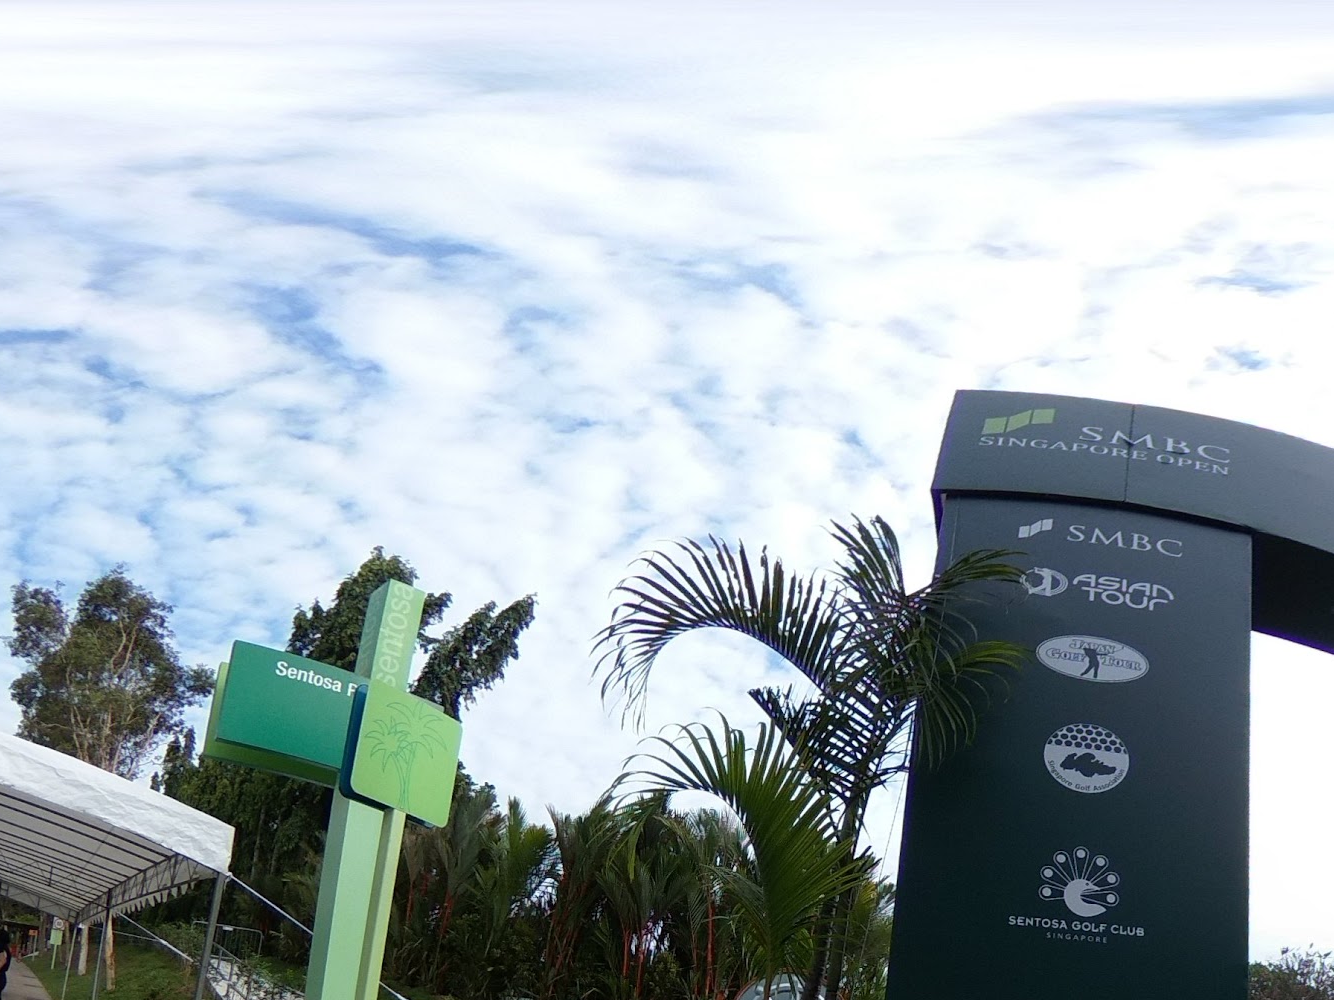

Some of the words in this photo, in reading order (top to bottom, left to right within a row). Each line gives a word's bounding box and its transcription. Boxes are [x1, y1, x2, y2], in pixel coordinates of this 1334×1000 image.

[978, 435, 1149, 461] SINGAPORE
[1156, 454, 1230, 475] OPEN
[1079, 426, 1230, 464] SMBC
[1067, 525, 1183, 557] SMBC
[1072, 573, 1175, 600] ASIAN
[1081, 586, 1169, 611] TOUR
[275, 661, 342, 693] Sentosa
[1048, 759, 1073, 787] Singapore
[1075, 783, 1091, 792] Golf
[1093, 768, 1125, 792] Association
[1008, 915, 1068, 931] SENTOSA
[1072, 921, 1107, 933] GOLF
[1110, 924, 1145, 937] CLUB
[1046, 931, 1108, 944] SINGAPORE
